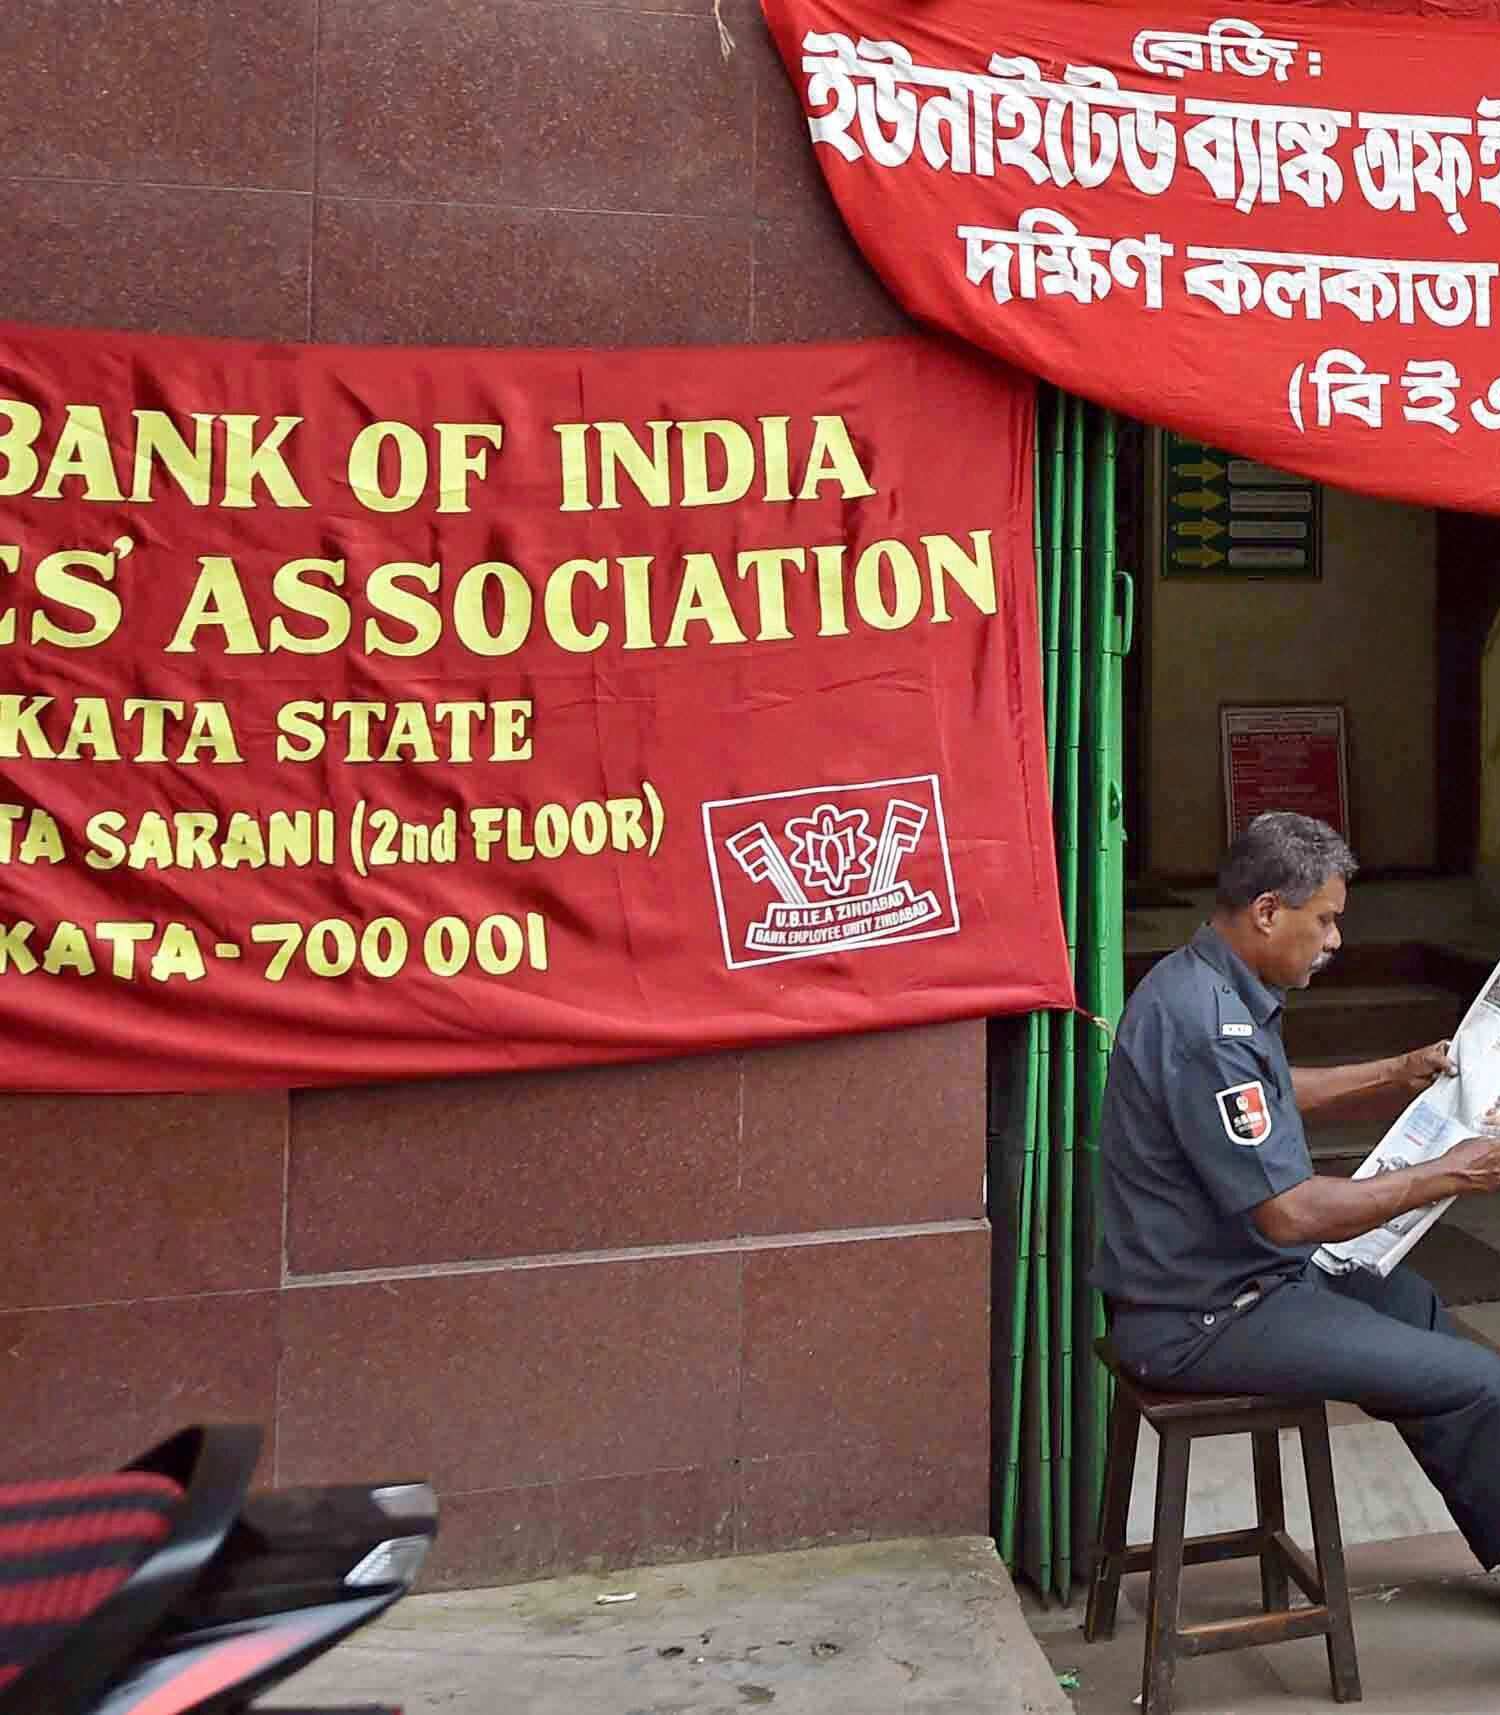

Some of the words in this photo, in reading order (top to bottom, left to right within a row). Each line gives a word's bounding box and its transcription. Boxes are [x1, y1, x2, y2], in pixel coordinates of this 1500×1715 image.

[802, 31, 1177, 196] ইউনাইটেড
[1184, 98, 1352, 215] ব্যাঙ্ক
[956, 207, 1174, 309] দক্ষিণ
[1184, 245, 1499, 327] কলকাতা
[1288, 348, 1390, 433] (বি
[1400, 359, 1462, 434] ই
[347, 420, 503, 514] OF
[553, 415, 877, 512] INDIA
[164, 530, 999, 659] ASSOCIATION
[0, 694, 244, 764] KATA
[276, 698, 534, 764] STATE
[84, 808, 335, 870] SARANI
[352, 799, 457, 877] (2nd
[471, 781, 665, 863] FLOOR)
[754, 928, 787, 945] BANK
[788, 926, 843, 945] EMPLOYEE
[874, 900, 929, 930] ZINDABAD
[836, 891, 905, 921] ZINDABAD
